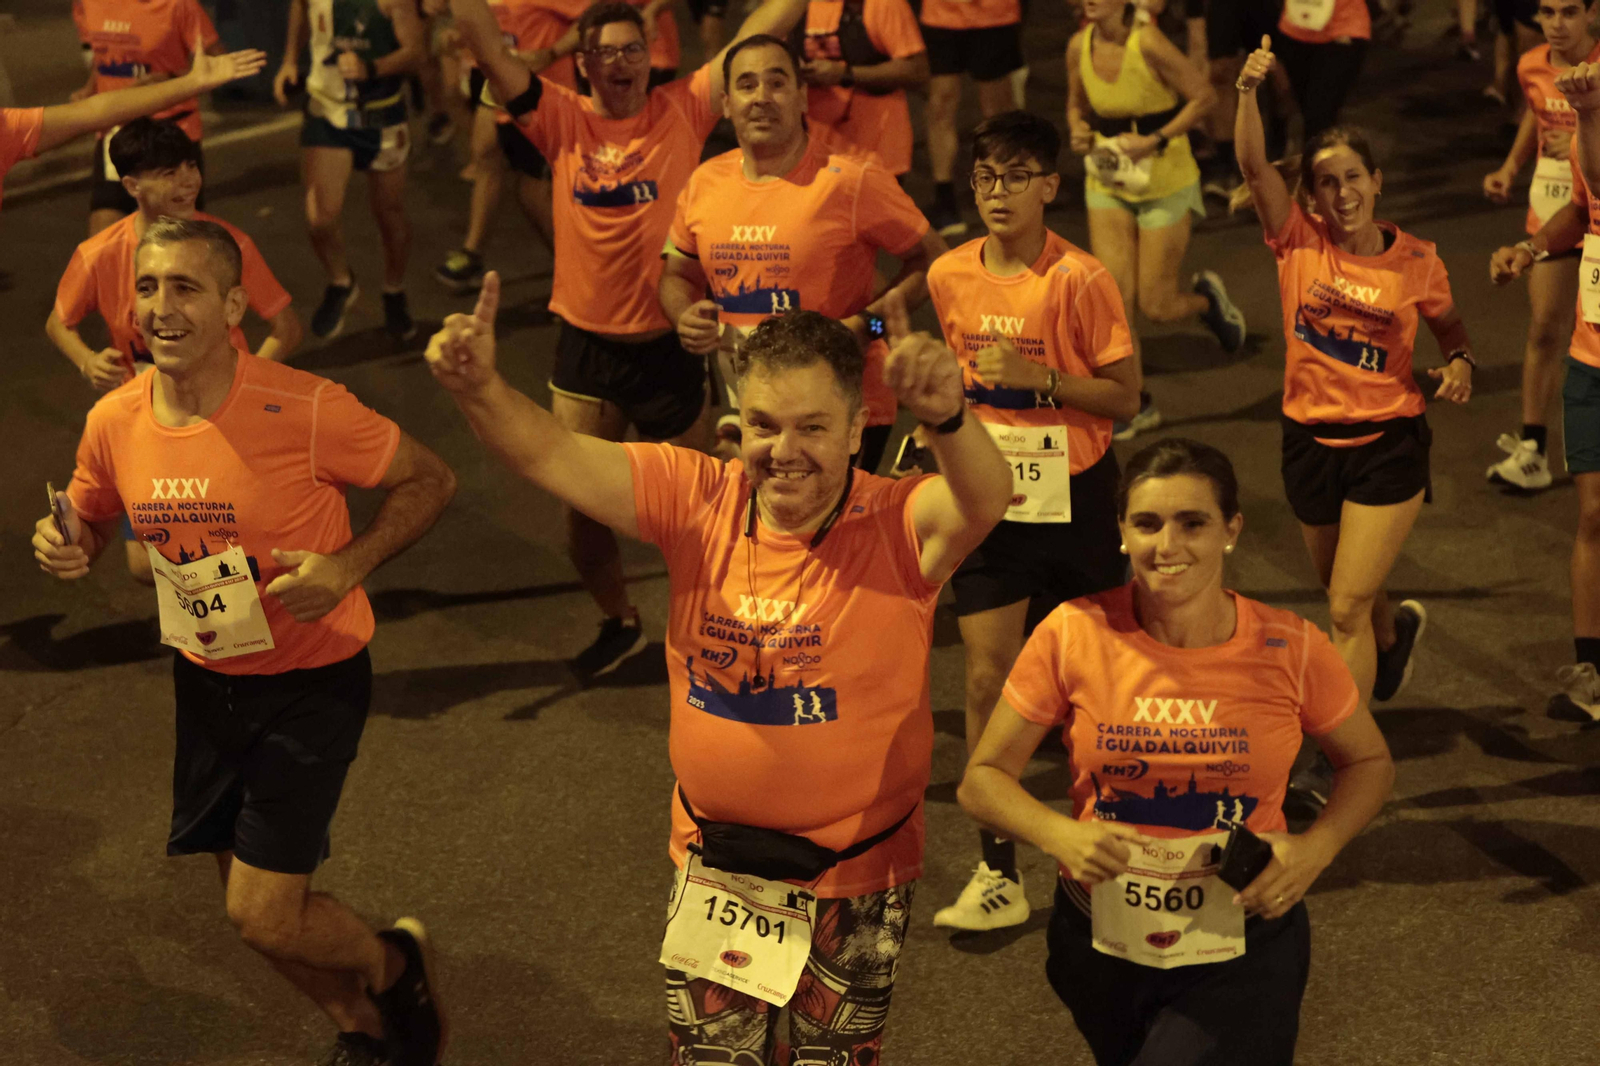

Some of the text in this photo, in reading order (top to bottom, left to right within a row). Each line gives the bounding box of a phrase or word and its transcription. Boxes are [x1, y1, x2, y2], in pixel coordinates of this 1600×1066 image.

[730, 225, 777, 242] XXXV
[710, 243, 746, 251] CARRERA
[715, 252, 790, 261] GUADALQUIVIR
[1333, 275, 1381, 304] XXXV
[979, 314, 1025, 334] XXXV
[151, 478, 210, 499] XXXV
[132, 502, 235, 511] CARRERA NOCTURNA
[138, 512, 237, 524] GUADALQUIVIR
[175, 590, 227, 619] 5604
[733, 594, 808, 625] XXXV
[704, 611, 754, 632] CARRERA
[706, 626, 823, 649] GUADALQUIVIR
[1133, 696, 1219, 725] XXXV
[1097, 723, 1249, 738] CARRERA NOCTURNA
[1105, 738, 1249, 754] GUADALQUIVIR
[1102, 764, 1138, 777] KH7
[1125, 881, 1204, 912] 5560
[704, 895, 785, 944] 15701
[723, 952, 747, 966] KH7
